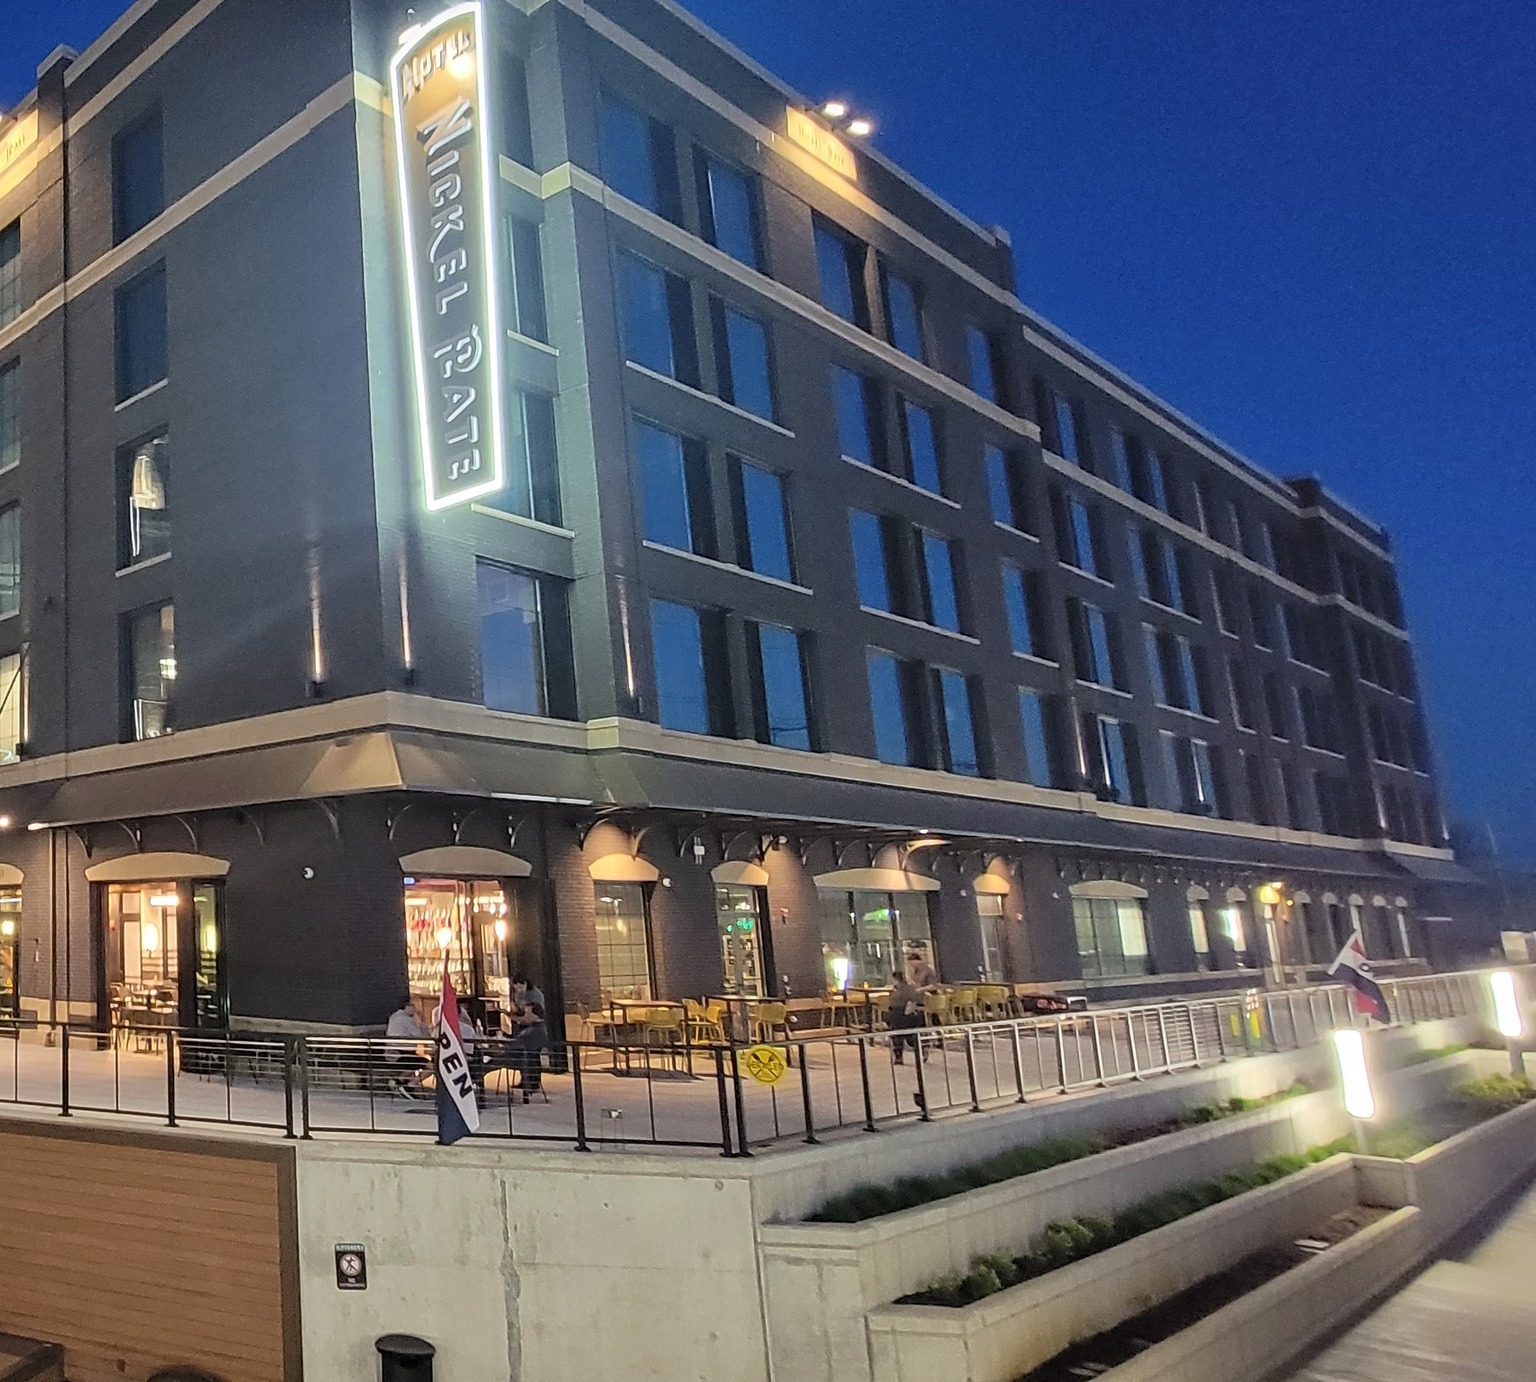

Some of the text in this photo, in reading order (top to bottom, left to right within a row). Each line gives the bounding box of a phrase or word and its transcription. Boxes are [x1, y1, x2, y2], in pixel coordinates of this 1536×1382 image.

[402, 29, 471, 103] HOTEL
[416, 95, 474, 315] NICKEL
[438, 1031, 473, 1099] PEN
